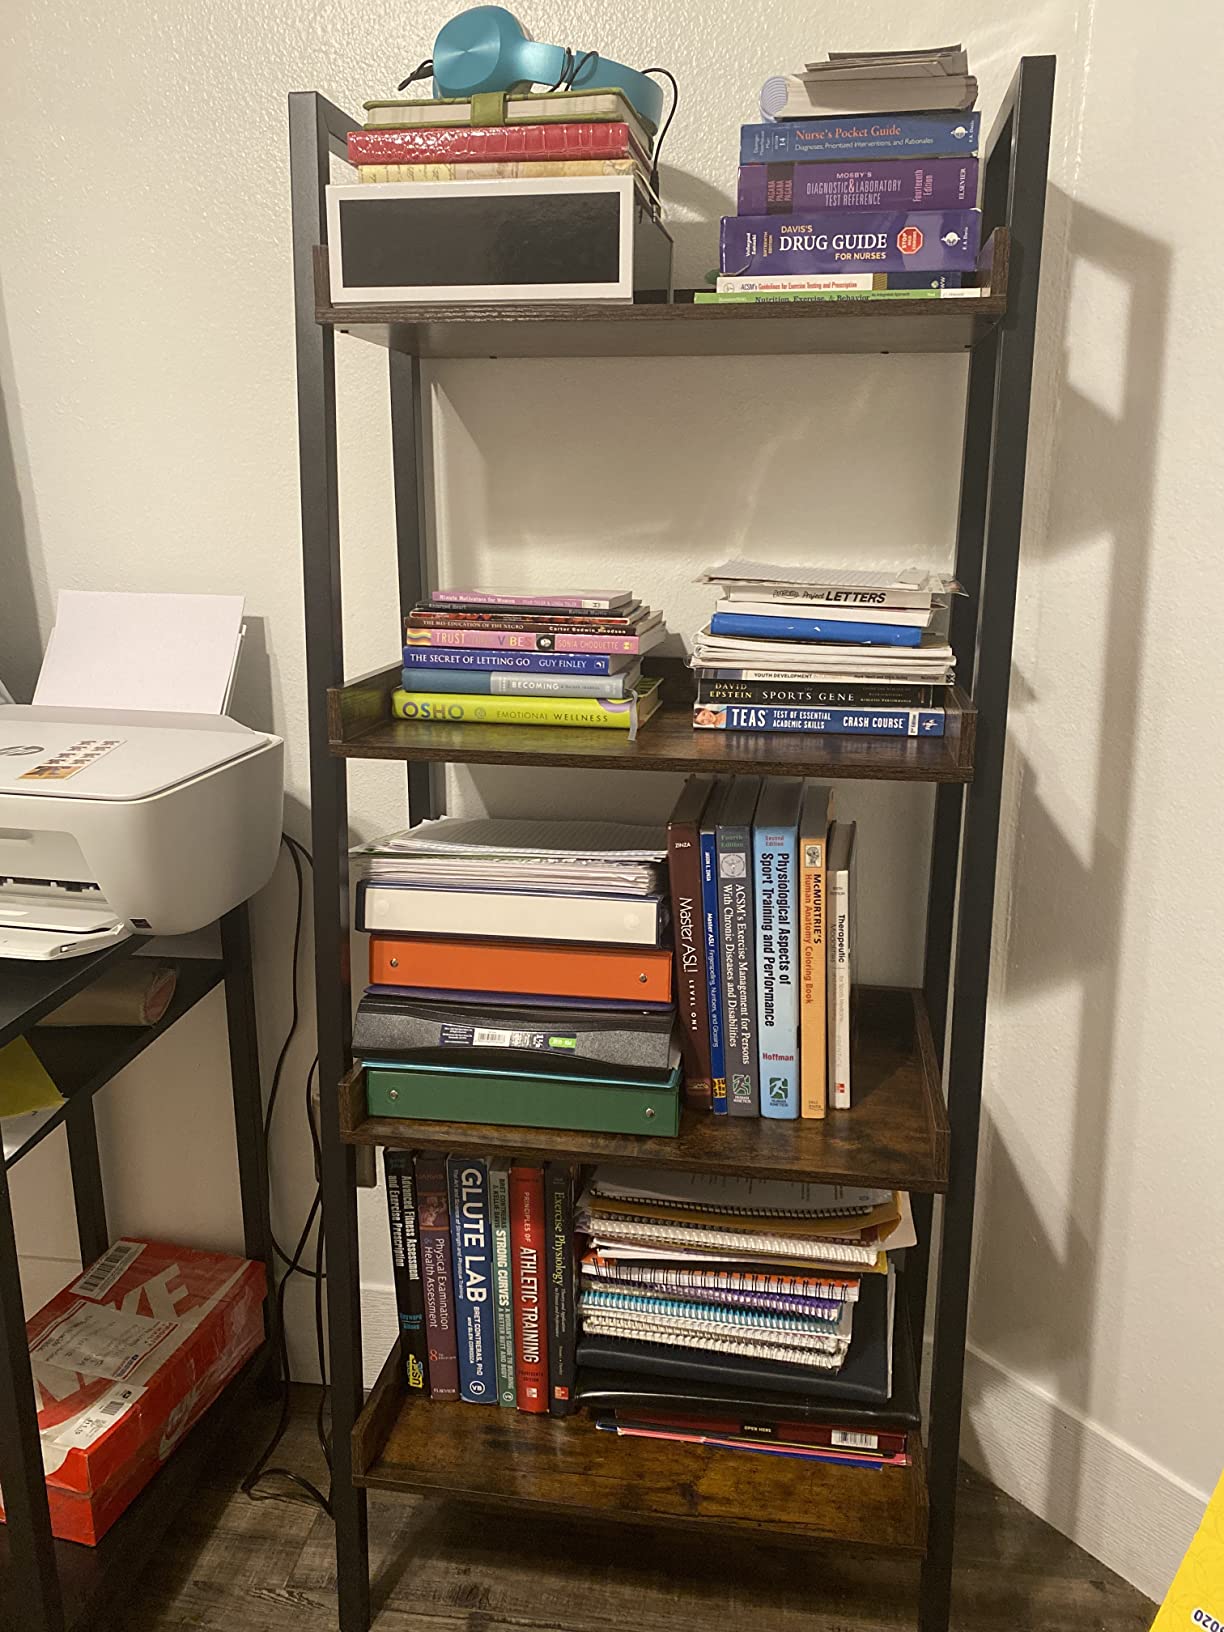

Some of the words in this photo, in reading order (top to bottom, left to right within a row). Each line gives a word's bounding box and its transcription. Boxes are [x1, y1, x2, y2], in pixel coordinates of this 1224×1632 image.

[794, 143, 824, 151] Diagnoses,
[825, 141, 853, 149] Prioritized
[854, 140, 892, 148] Interventions,
[904, 137, 934, 146] Rationales
[795, 129, 832, 141] Nurse's
[835, 126, 868, 138] Pocket
[870, 124, 901, 136] Guide
[806, 181, 848, 195] DIAGNOSTIC
[848, 178, 855, 193] &
[855, 179, 902, 193] LABORATORY
[836, 171, 872, 179] MOSBY'S
[912, 169, 923, 202] Fourteenth
[923, 175, 933, 196] Edition
[958, 167, 967, 200] ELSEVIER
[768, 180, 776, 201] PAGANA
[775, 180, 784, 201] PAGANA
[784, 180, 792, 201] PAGANA
[825, 194, 841, 206] TEST
[843, 193, 881, 206] REFERENCE
[781, 225, 813, 234] DAVIS'S
[779, 235, 828, 251] DRUG
[832, 233, 888, 250] GUIDE
[853, 252, 887, 260] NURSES
[740, 283, 758, 291] ACSM's
[822, 281, 831, 289] and
[755, 295, 791, 303] Nutrition,
[836, 294, 870, 302] Behavior
[802, 590, 825, 600] Project
[825, 590, 886, 604] LETTERS
[435, 632, 465, 644] TRUST
[559, 639, 578, 648] SONIA
[580, 640, 618, 650] CHOQUETTE
[410, 653, 427, 662] THE
[429, 654, 460, 663] SECRET
[462, 655, 474, 664] OF
[476, 656, 514, 665] LETTING
[515, 657, 530, 666] GO
[538, 659, 557, 667] GUY
[558, 660, 587, 668] FINLEY
[511, 681, 559, 690] BECOMING
[709, 690, 753, 698] EPSTEIN
[762, 690, 812, 700] SPORTS
[818, 692, 855, 702] GENE
[402, 701, 464, 720] OSHO
[496, 711, 548, 720] EMOTIONAL
[553, 713, 608, 722] WELLNESS
[732, 708, 766, 727] TEAS
[773, 710, 788, 718] TEST
[789, 711, 797, 719] OF
[799, 711, 831, 721] ESSENTIAL
[842, 716, 869, 728] CRASH
[872, 717, 904, 728] COURSE
[772, 719, 802, 728] ACADEMIC
[803, 720, 825, 729] SKILLS
[760, 853, 774, 884] Sport
[723, 884, 733, 905] With
[776, 853, 790, 925] Physiological
[805, 874, 813, 903] Human
[735, 884, 746, 921] ACSM's
[761, 887, 775, 931] Training
[813, 874, 822, 944] McMURTRIE'S
[679, 897, 694, 942] Master
[723, 907, 735, 941] Chronic
[804, 905, 813, 944] Anatomy
[737, 923, 748, 959] Exercise
[763, 934, 775, 954] and
[777, 927, 791, 970] Aspects
[837, 914, 846, 963] Therapeutic
[681, 943, 699, 973] ASL!
[724, 943, 736, 981] Diseases
[804, 945, 814, 981] Coloring
[727, 982, 737, 998] and
[737, 961, 750, 1015] Management
[779, 974, 791, 985] of
[688, 980, 696, 1006] LEVEL
[764, 957, 776, 1027] Performance
[806, 983, 814, 1004] Book
[690, 1012, 698, 1031] ONE
[711, 1013, 719, 1025] and
[728, 1000, 738, 1047] Disabilities
[741, 1017, 751, 1031] for
[741, 1032, 751, 1065] Persons
[762, 1053, 794, 1061] Hoffman
[388, 1175, 400, 1188] and
[401, 1175, 415, 1209] Advanced
[390, 1190, 401, 1221] Exercise
[461, 1168, 485, 1248] GLUTE
[523, 1191, 531, 1232] PRINCIPLES
[554, 1192, 565, 1232] Exercise
[405, 1211, 416, 1236] Fitness
[392, 1223, 406, 1267] Prescription
[496, 1229, 508, 1267] STRONG
[524, 1233, 531, 1243] OF
[407, 1239, 420, 1280] Assessment
[424, 1246, 435, 1275] Health
[434, 1238, 446, 1274] Physical
[552, 1234, 566, 1286] Physiology
[465, 1255, 488, 1302] LAB
[520, 1246, 538, 1303] ATHLETIC
[498, 1269, 509, 1306] CURVES
[427, 1277, 438, 1328] Assessment
[438, 1276, 449, 1330] Examination
[522, 1306, 540, 1363] TRAINING
[430, 1349, 438, 1361] 8
[1194, 1609, 1224, 1632] 020
